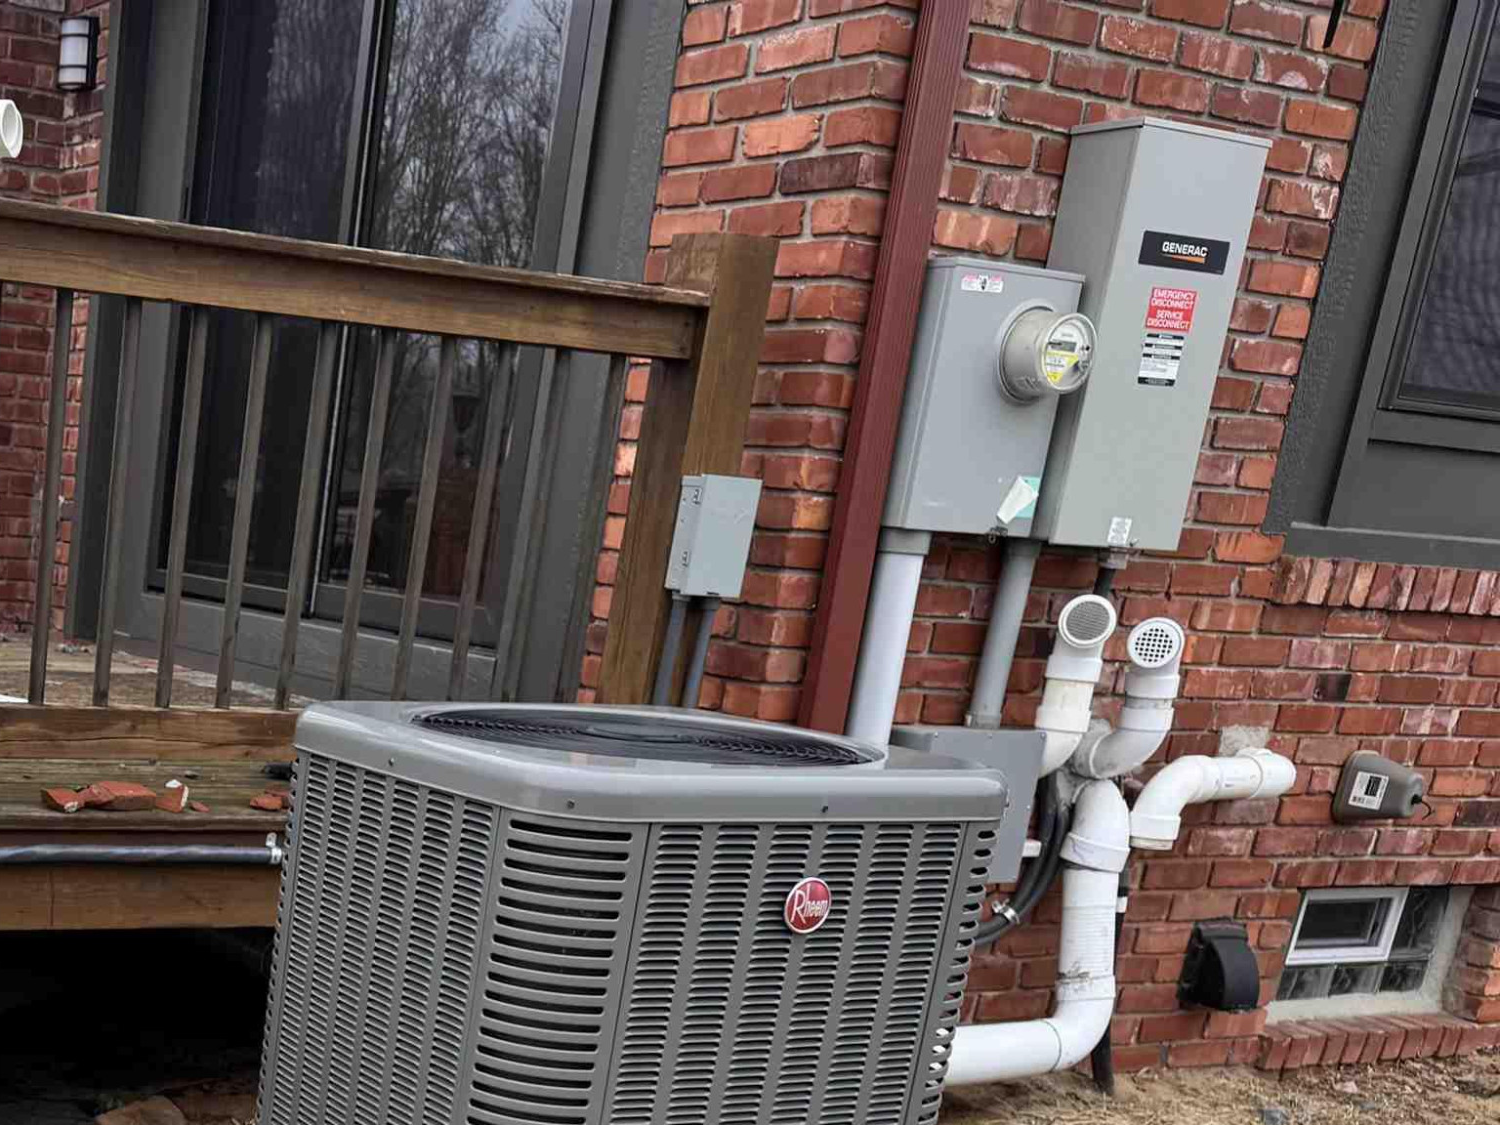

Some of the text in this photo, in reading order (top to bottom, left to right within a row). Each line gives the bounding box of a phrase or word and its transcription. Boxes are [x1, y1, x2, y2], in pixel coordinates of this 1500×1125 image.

[1162, 241, 1208, 257] GENERAC
[1153, 288, 1195, 301] EMERGENCY
[1150, 298, 1193, 310] DISCONNECT
[1156, 310, 1183, 320] SERVICE
[1147, 318, 1190, 329] DISCONNECT
